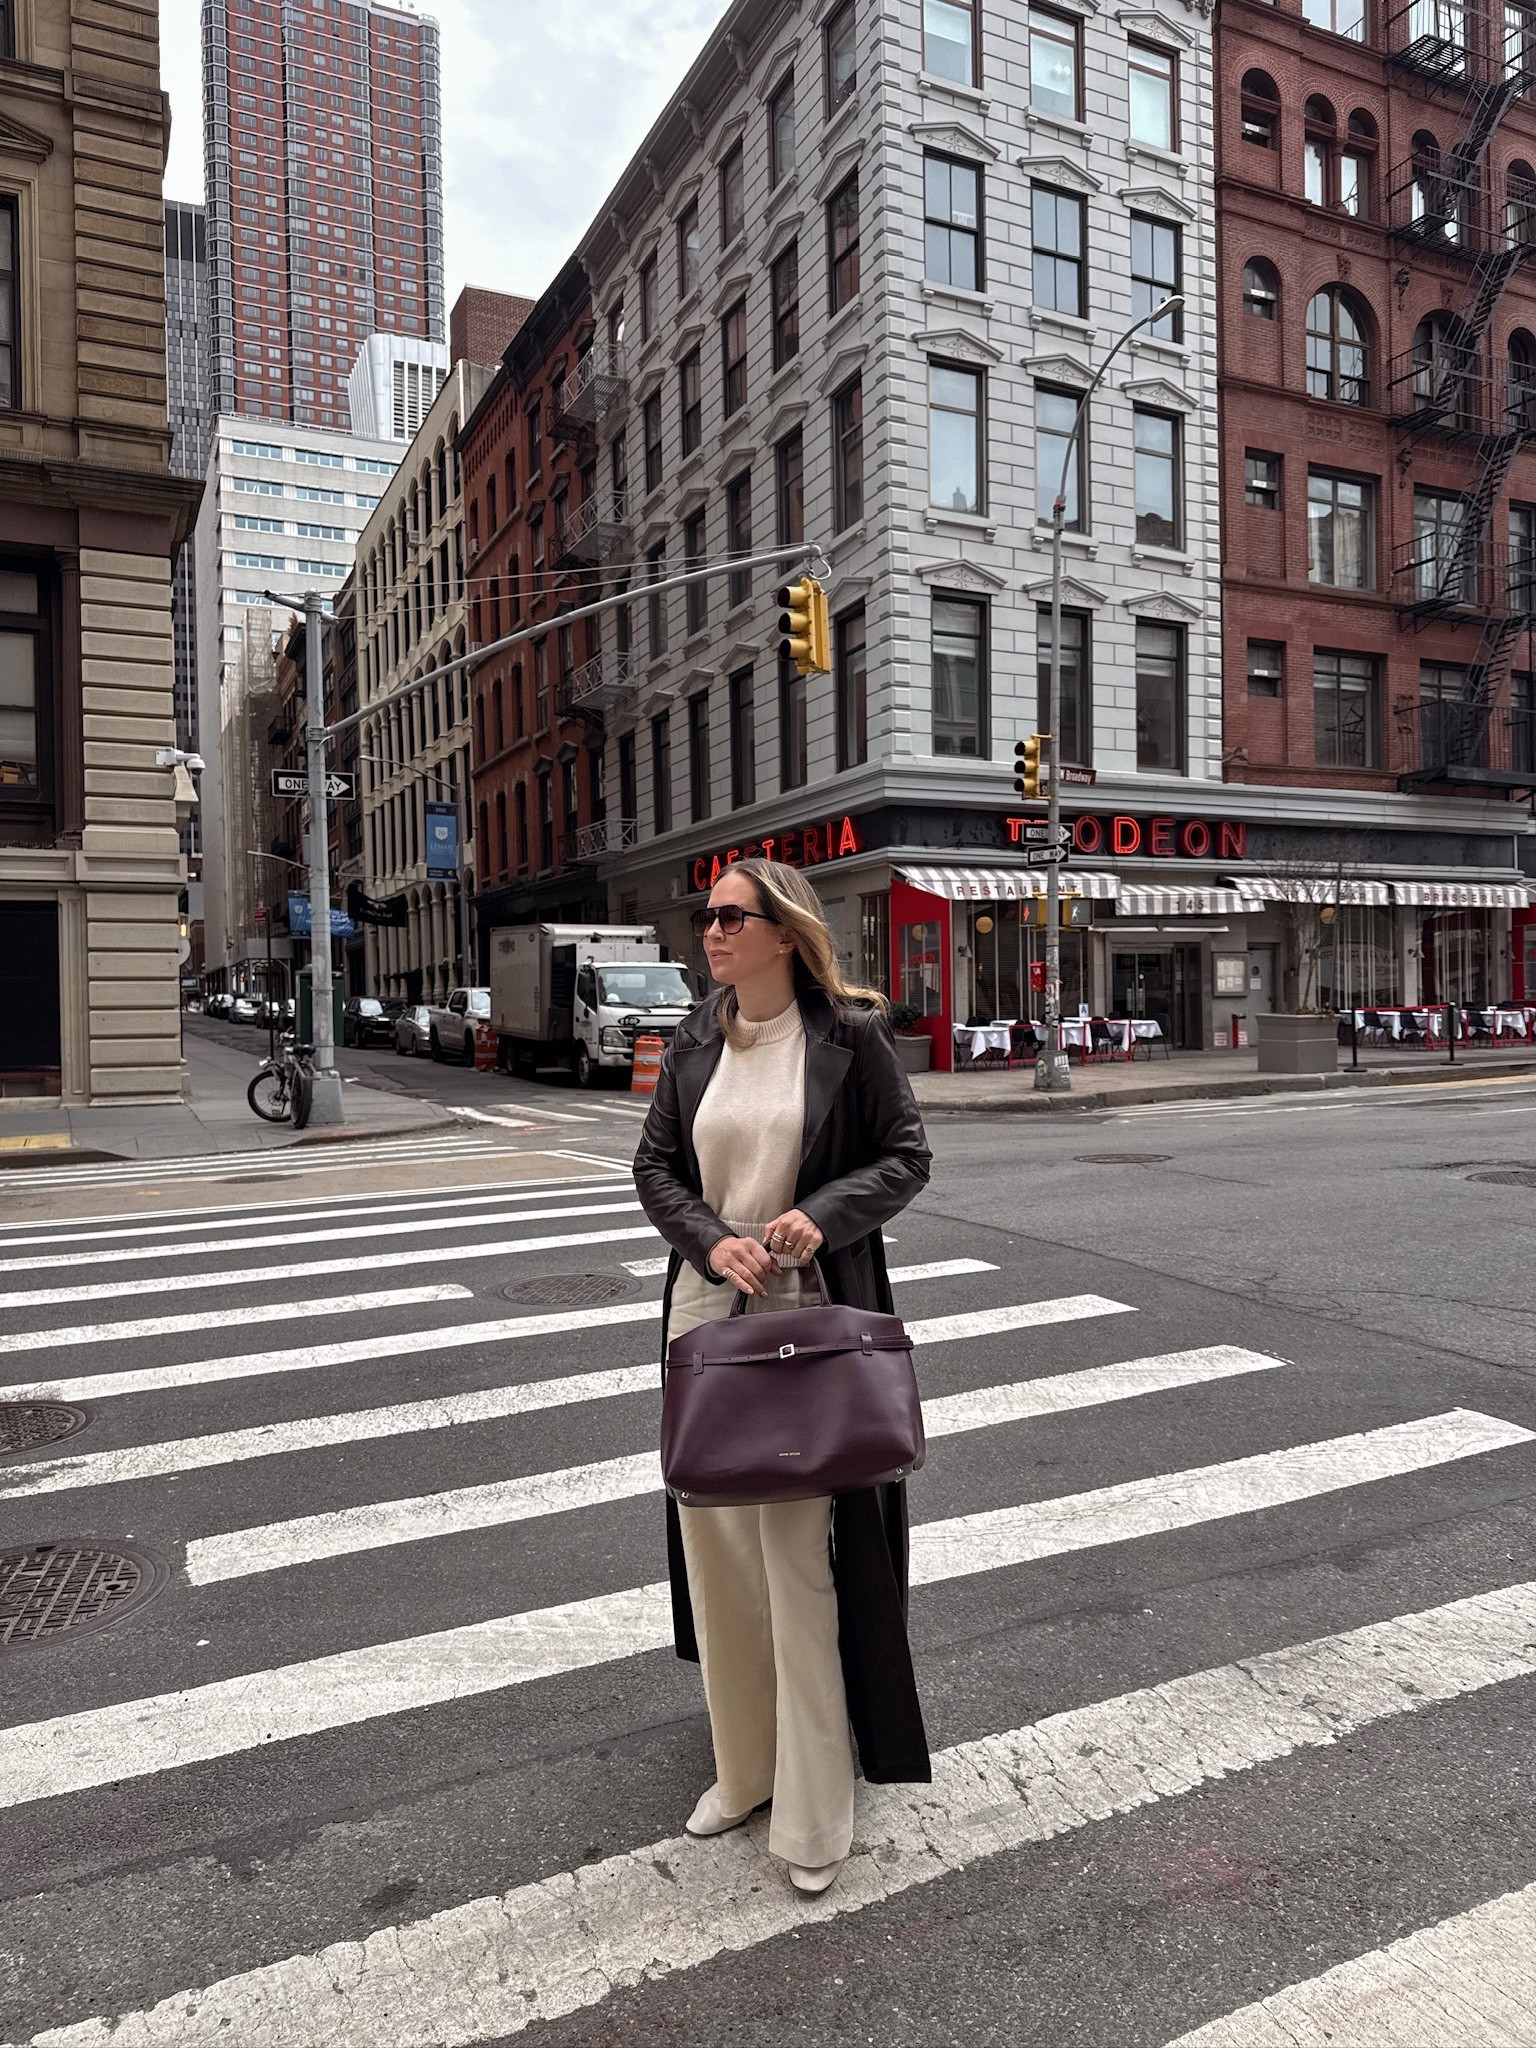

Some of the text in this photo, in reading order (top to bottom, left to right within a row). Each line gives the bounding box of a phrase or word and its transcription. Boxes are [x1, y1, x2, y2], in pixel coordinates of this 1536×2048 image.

[1066, 770, 1092, 785] Broadway
[285, 779, 342, 791] ONE AY
[1030, 828, 1045, 838] ONE
[1075, 814, 1247, 858] ODEON
[1033, 849, 1063, 861] ONE WAY
[956, 885, 1078, 896] RESTAURNT
[1423, 892, 1504, 904] BRASSERIE
[1176, 899, 1204, 911] 145
[1081, 1006, 1087, 1014] A
